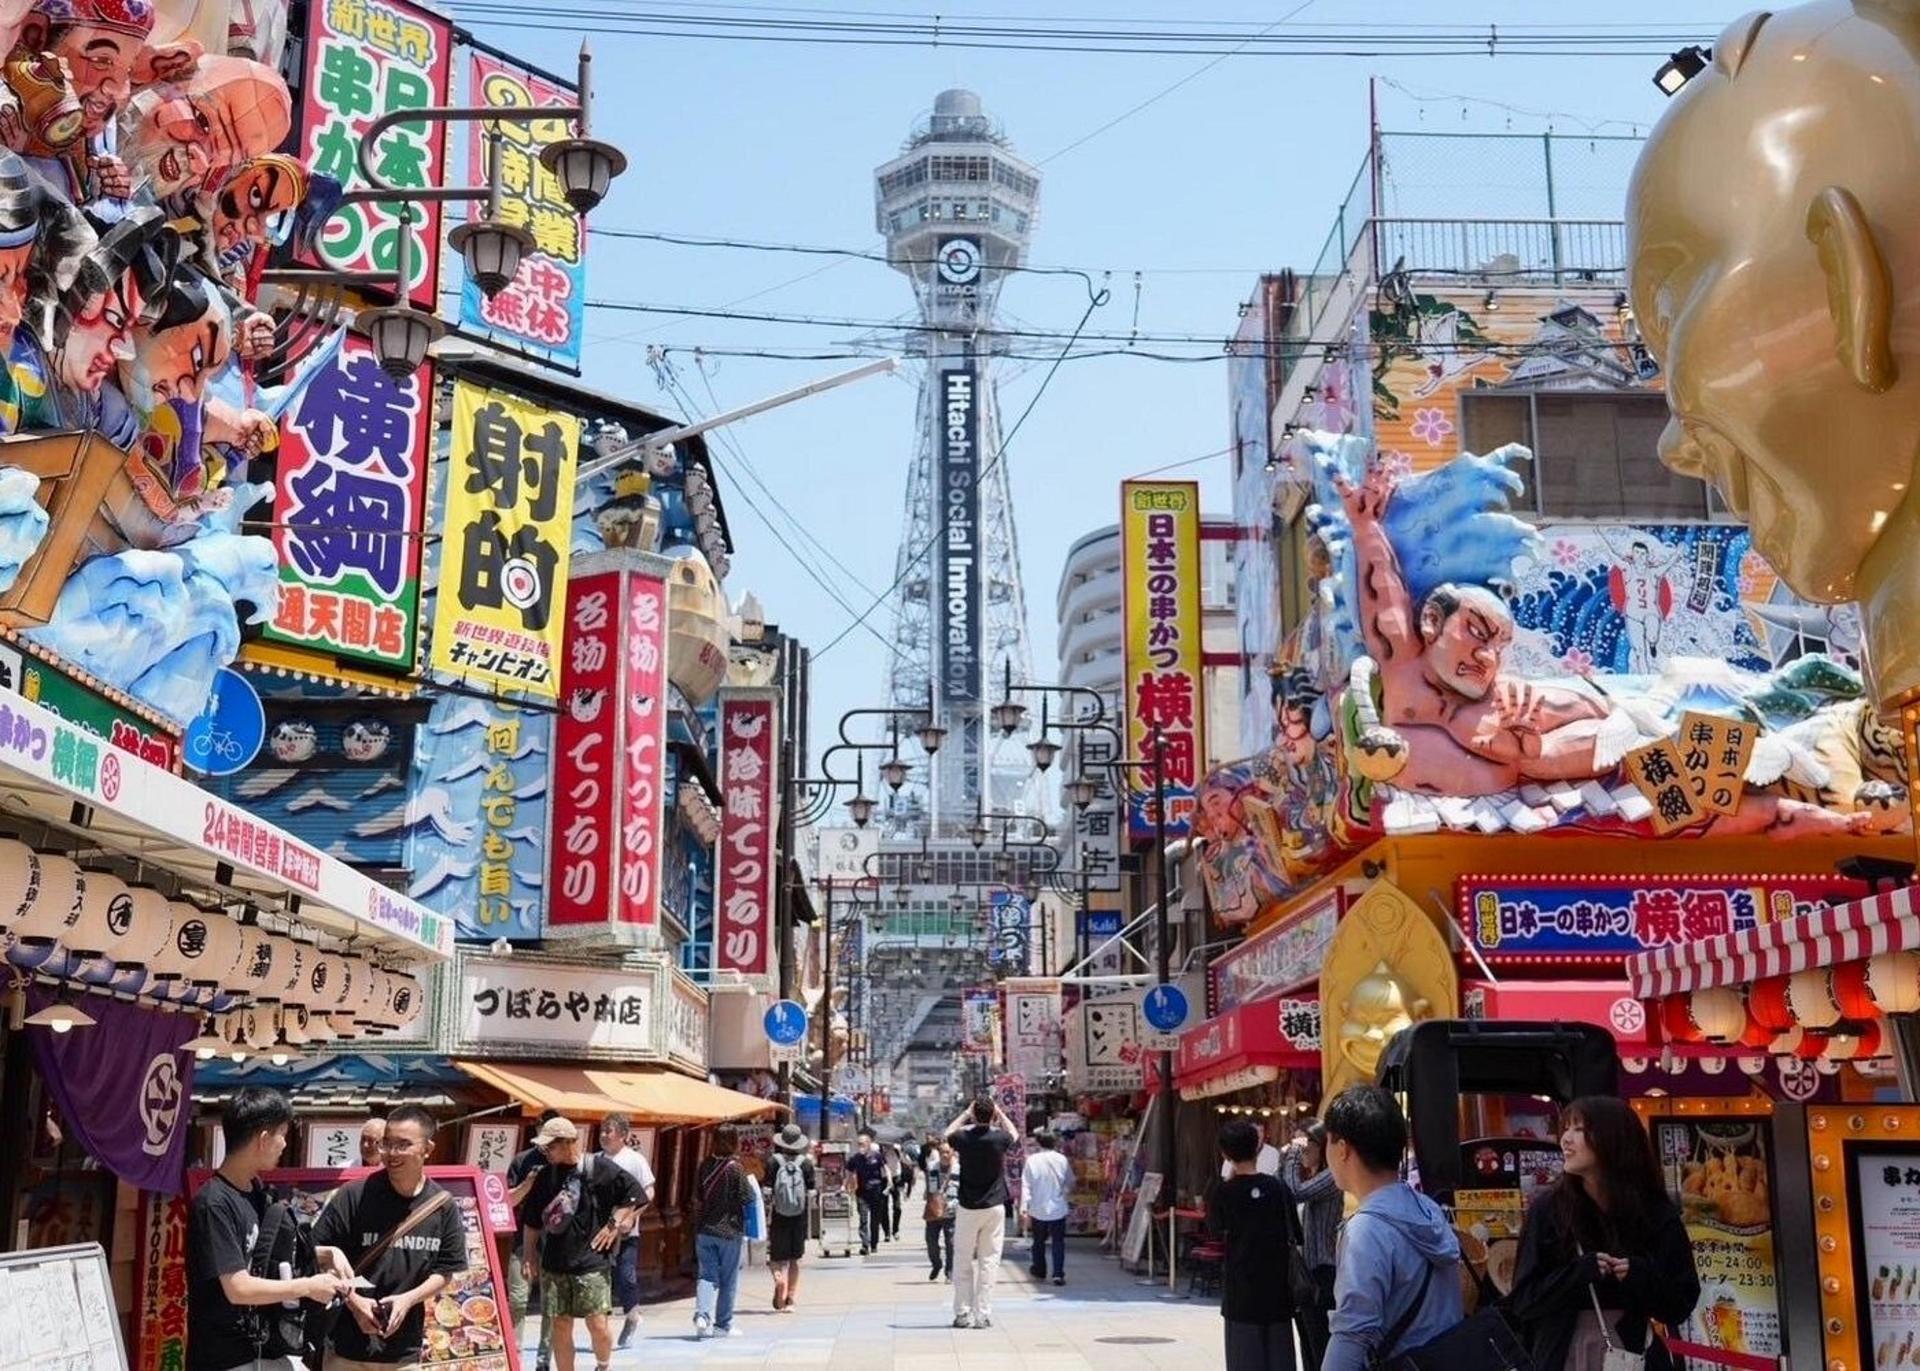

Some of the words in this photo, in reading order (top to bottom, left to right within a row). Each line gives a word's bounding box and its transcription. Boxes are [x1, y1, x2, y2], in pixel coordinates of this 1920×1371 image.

[329, 0, 432, 68] 新世界
[485, 291, 566, 338] 無休
[948, 375, 972, 464] Hitachi
[287, 355, 412, 596] 横綱
[948, 471, 973, 550] Social
[458, 402, 567, 632] 射的
[274, 585, 404, 653] 通天閣店
[948, 557, 973, 696] Innovation
[1147, 514, 1180, 669] 日本一の串かつ
[449, 641, 551, 683] チャンピオン
[571, 591, 609, 674] 名物
[630, 591, 660, 677] 名物
[1136, 671, 1195, 790] 横綱
[1685, 720, 1714, 797] 串かつ
[1712, 727, 1742, 807] 日本一の
[1639, 747, 1694, 825] 横綱
[203, 801, 282, 873] 24時間営業
[1500, 901, 1631, 936] 日本一の串かつ
[1633, 889, 1728, 945] 横綱
[473, 985, 643, 1026] づぼらや本店
[389, 1235, 442, 1252] ANDER
